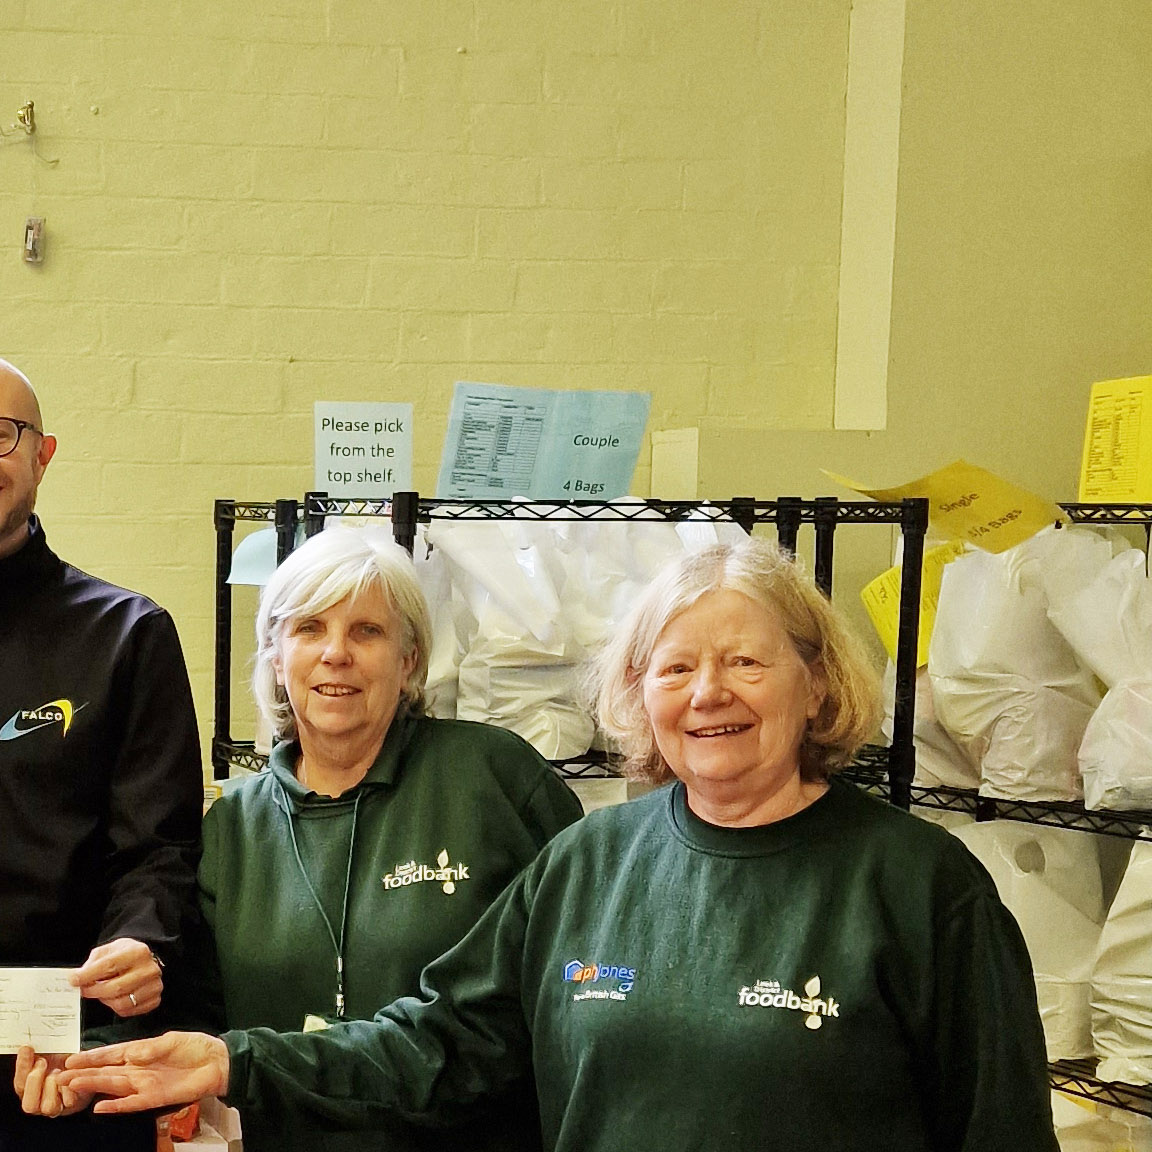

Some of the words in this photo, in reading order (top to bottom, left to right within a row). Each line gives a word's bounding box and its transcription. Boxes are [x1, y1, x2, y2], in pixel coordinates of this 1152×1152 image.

[322, 417, 370, 432] Please
[374, 418, 404, 435] pick
[329, 442, 365, 456] from
[370, 443, 395, 457] the
[573, 434, 620, 450] Couple
[328, 469, 352, 485] top
[356, 467, 396, 483] shelf.
[563, 480, 571, 491] 4
[575, 479, 605, 495] Bags
[939, 493, 980, 513] Single
[988, 509, 1023, 529] Bags
[21, 711, 64, 721] FALCO
[382, 861, 471, 890] foodbank
[737, 986, 840, 1018] foodbank
